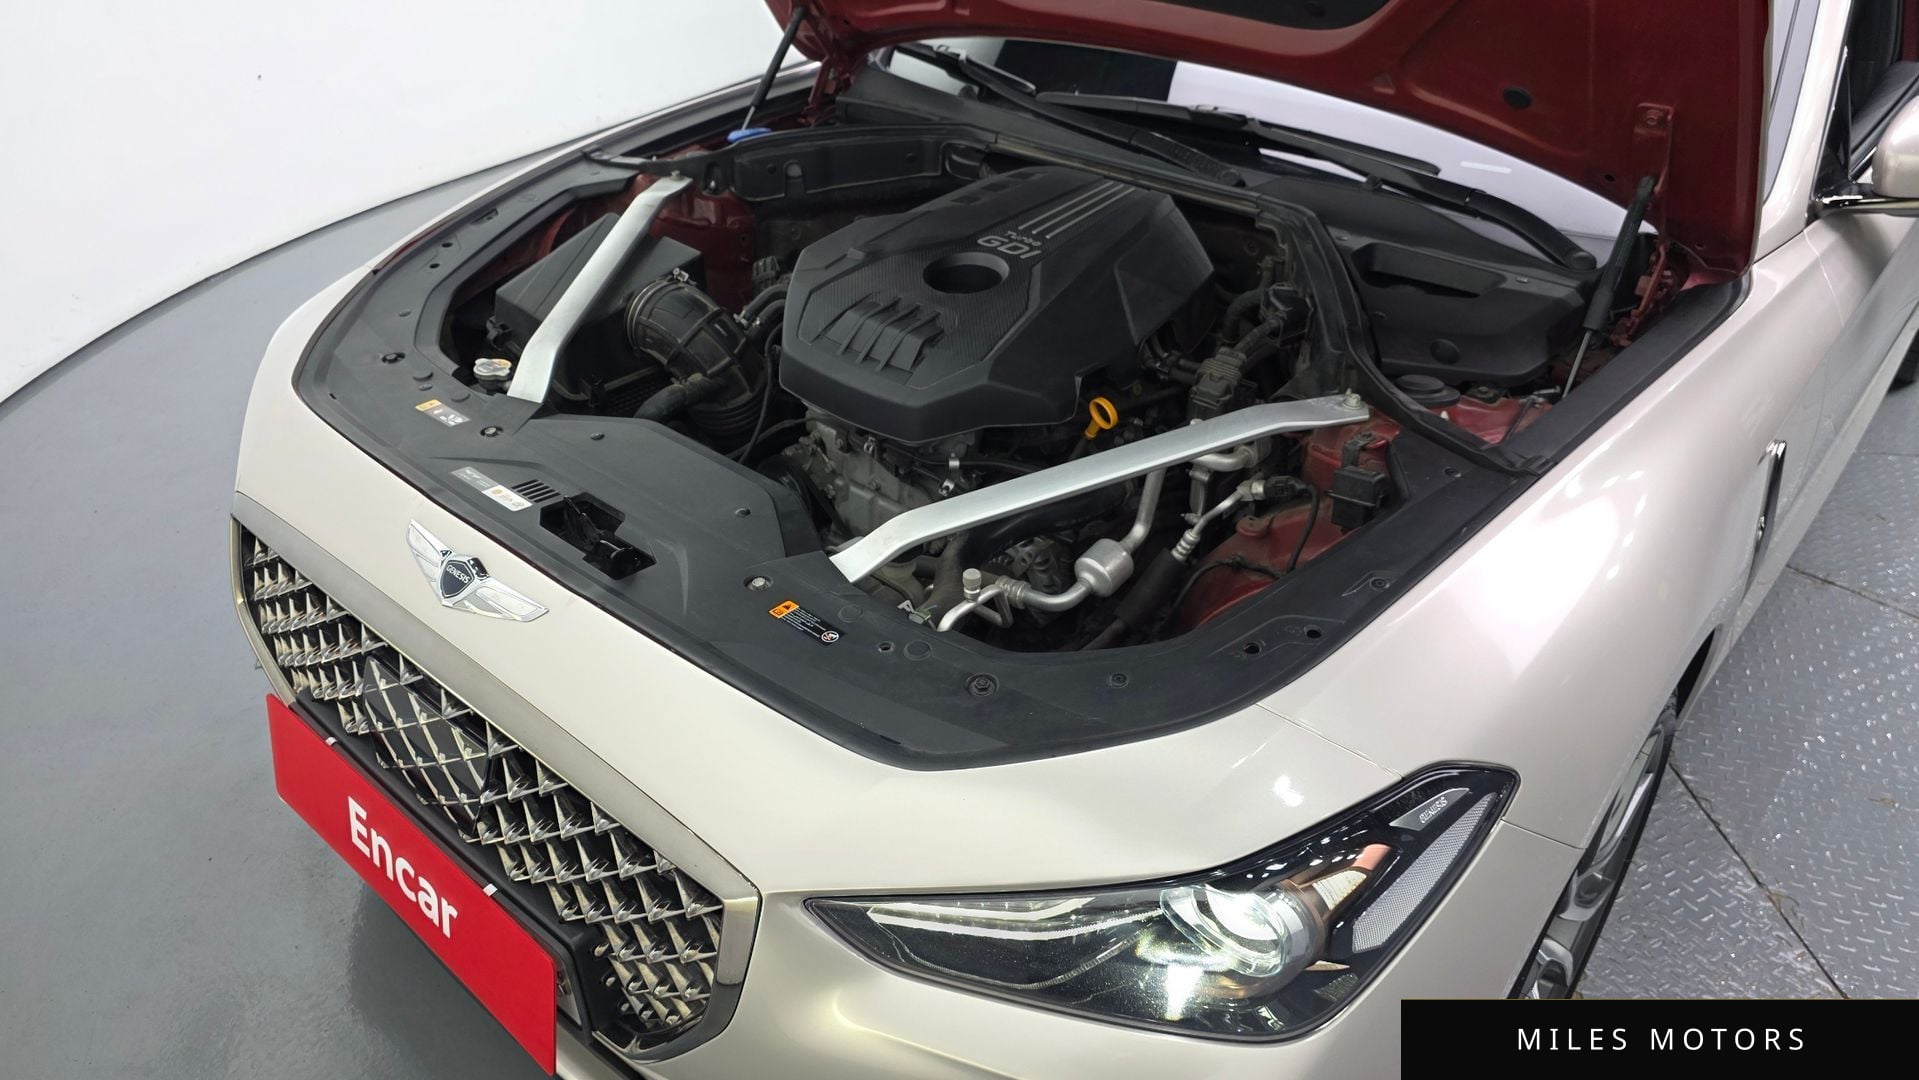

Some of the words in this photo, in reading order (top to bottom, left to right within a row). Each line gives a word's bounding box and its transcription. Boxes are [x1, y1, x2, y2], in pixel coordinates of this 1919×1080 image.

[977, 235, 1041, 258] GDI
[446, 564, 471, 583] GENESIS
[1419, 796, 1448, 823] GENESIS
[348, 796, 458, 938] Encar
